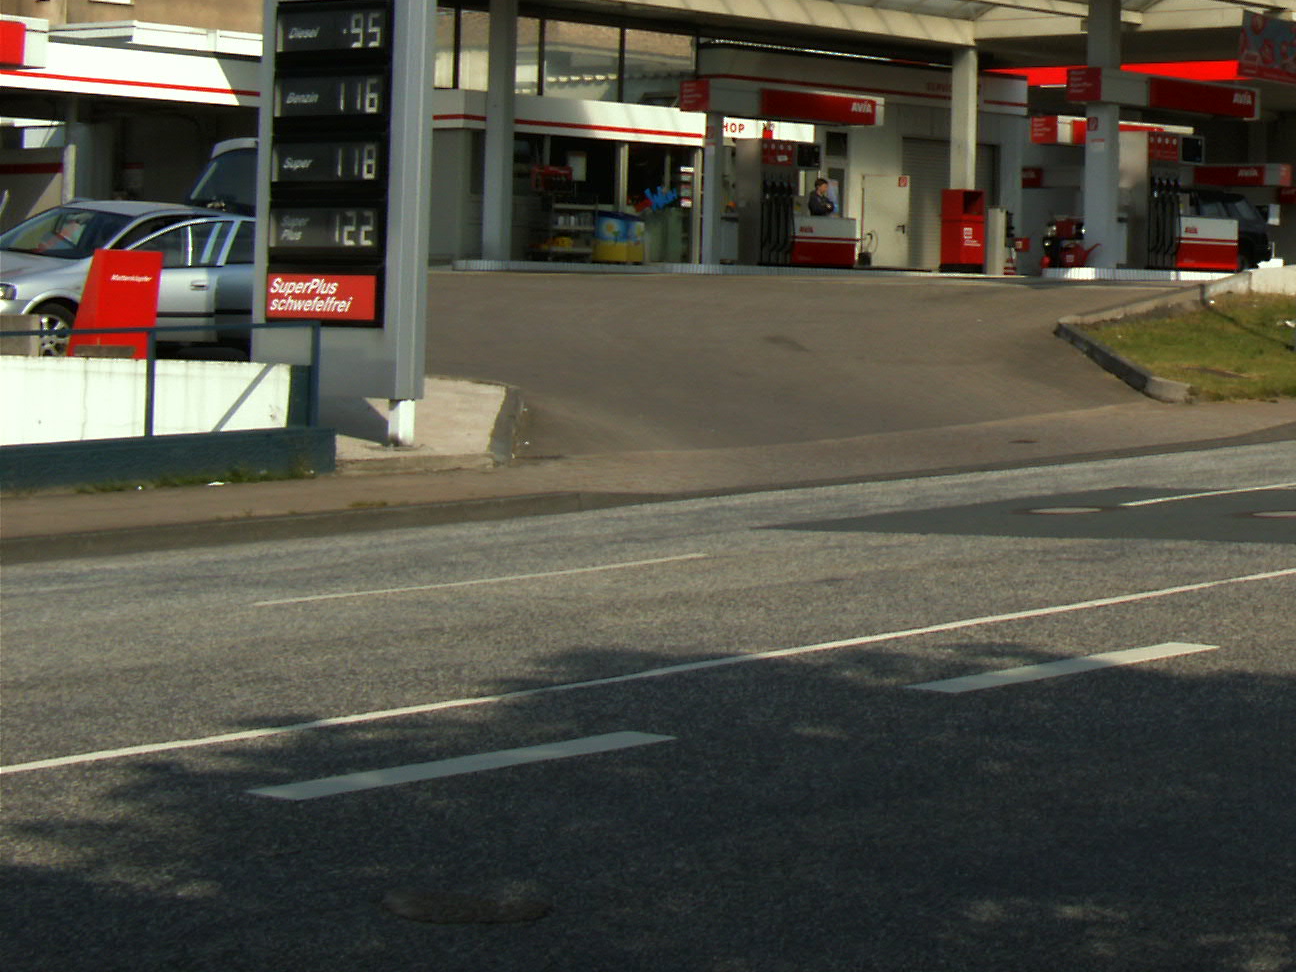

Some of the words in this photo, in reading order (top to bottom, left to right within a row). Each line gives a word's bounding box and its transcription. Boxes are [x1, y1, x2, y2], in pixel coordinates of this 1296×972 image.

[723, 123, 745, 133] HOP
[283, 158, 313, 171] Super
[270, 277, 339, 297] SuperPlus
[270, 296, 354, 313] schwefelfrei
